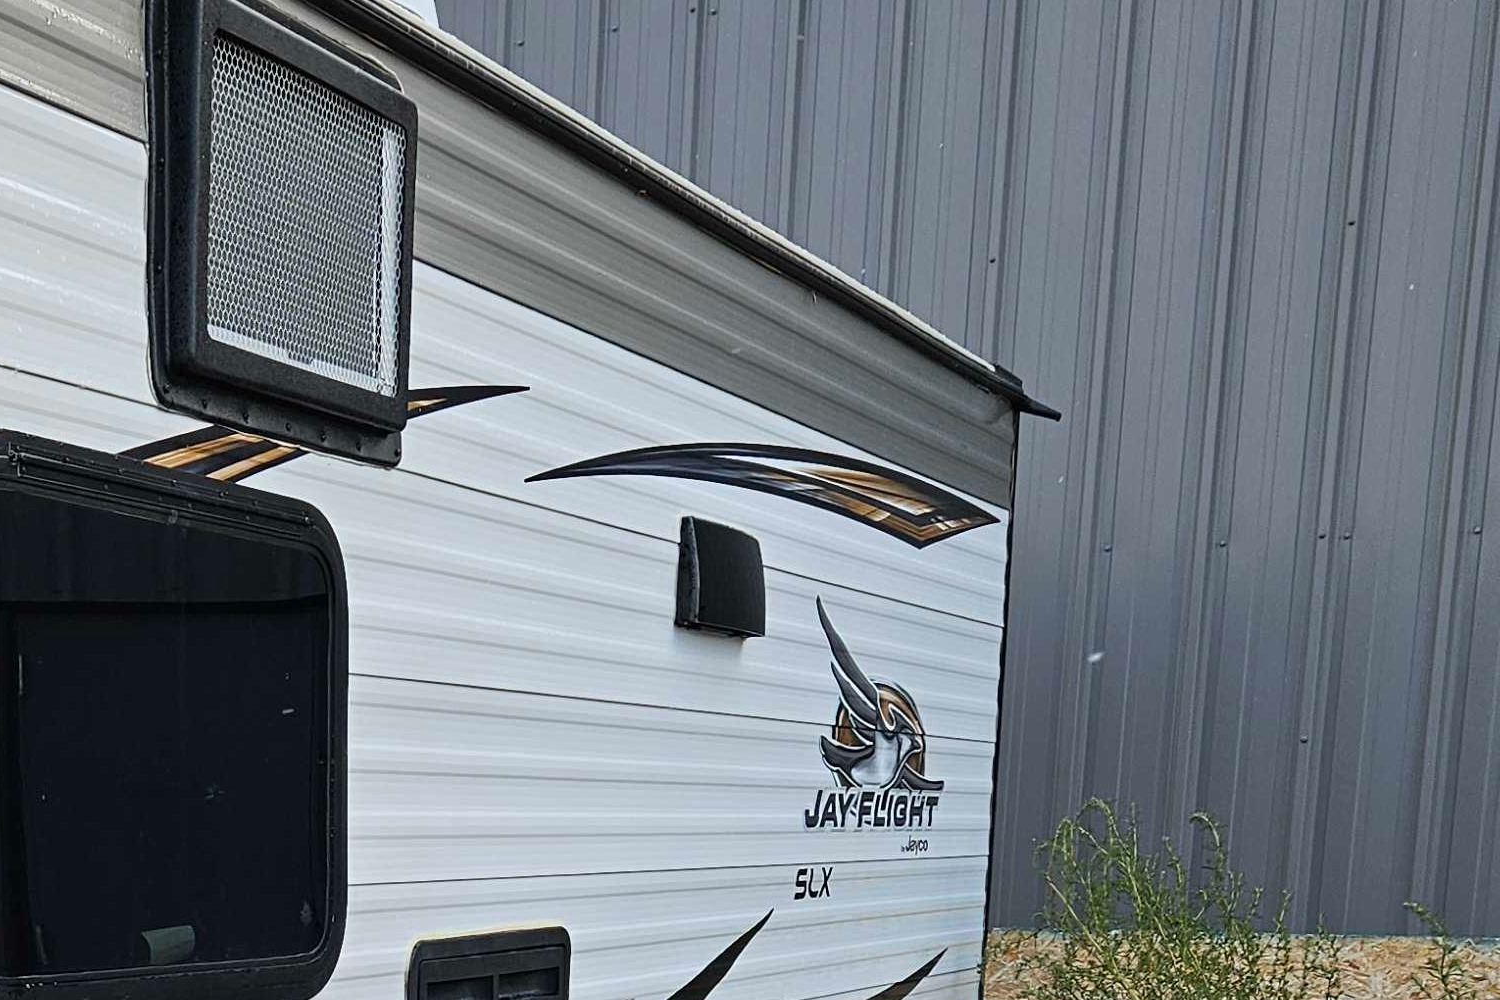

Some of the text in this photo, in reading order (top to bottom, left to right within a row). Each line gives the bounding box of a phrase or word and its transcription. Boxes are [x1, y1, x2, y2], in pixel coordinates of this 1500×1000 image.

[804, 790, 939, 829] JAY FLIGHT
[794, 866, 833, 900] SLX
